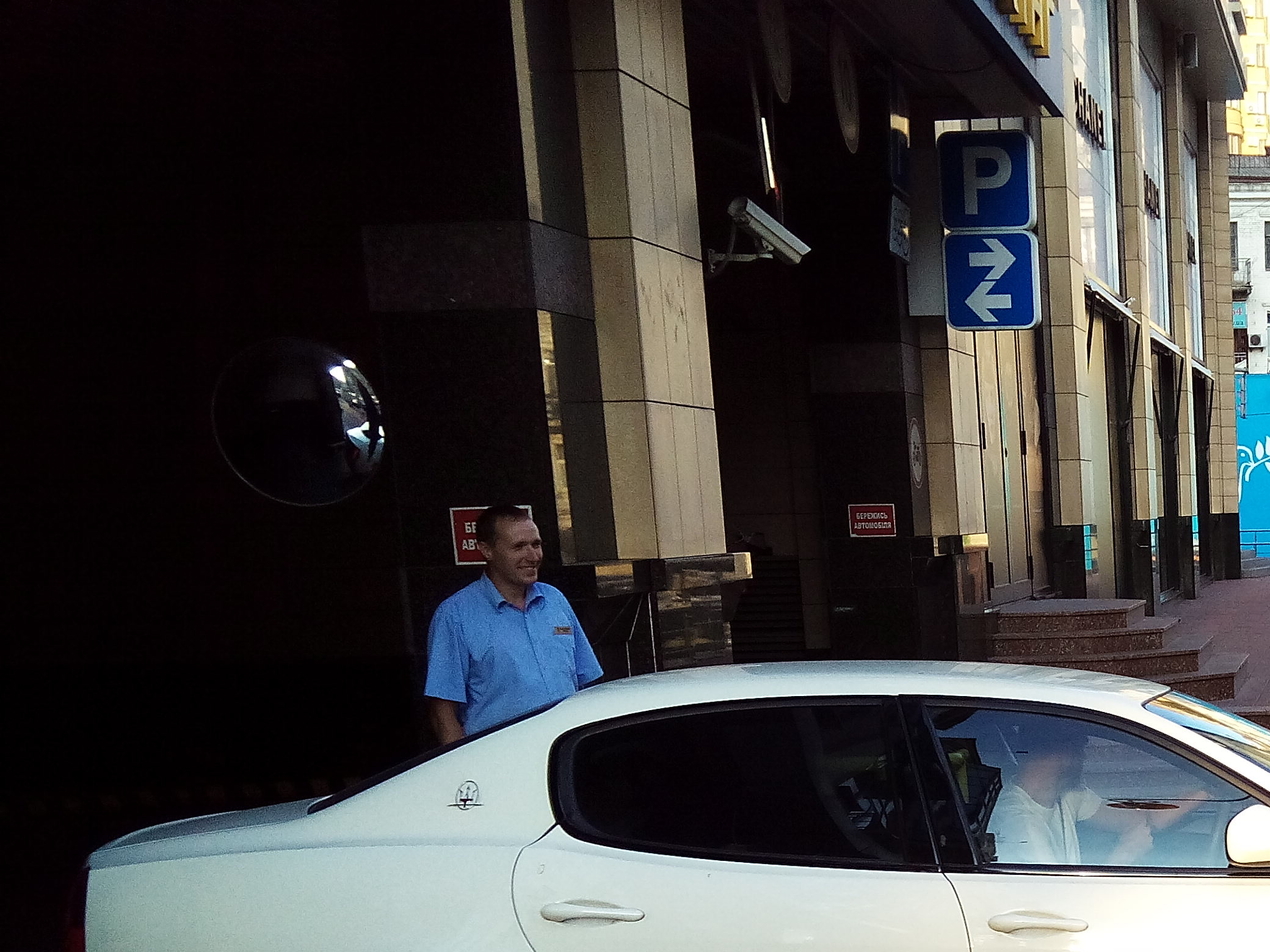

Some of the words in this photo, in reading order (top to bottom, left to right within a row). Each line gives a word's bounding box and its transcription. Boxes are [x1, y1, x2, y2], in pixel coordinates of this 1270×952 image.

[962, 146, 1012, 215] P
[855, 512, 888, 520] БЕРЕЖИСЬ
[854, 521, 892, 530] АВТОМОБІЛЯ
